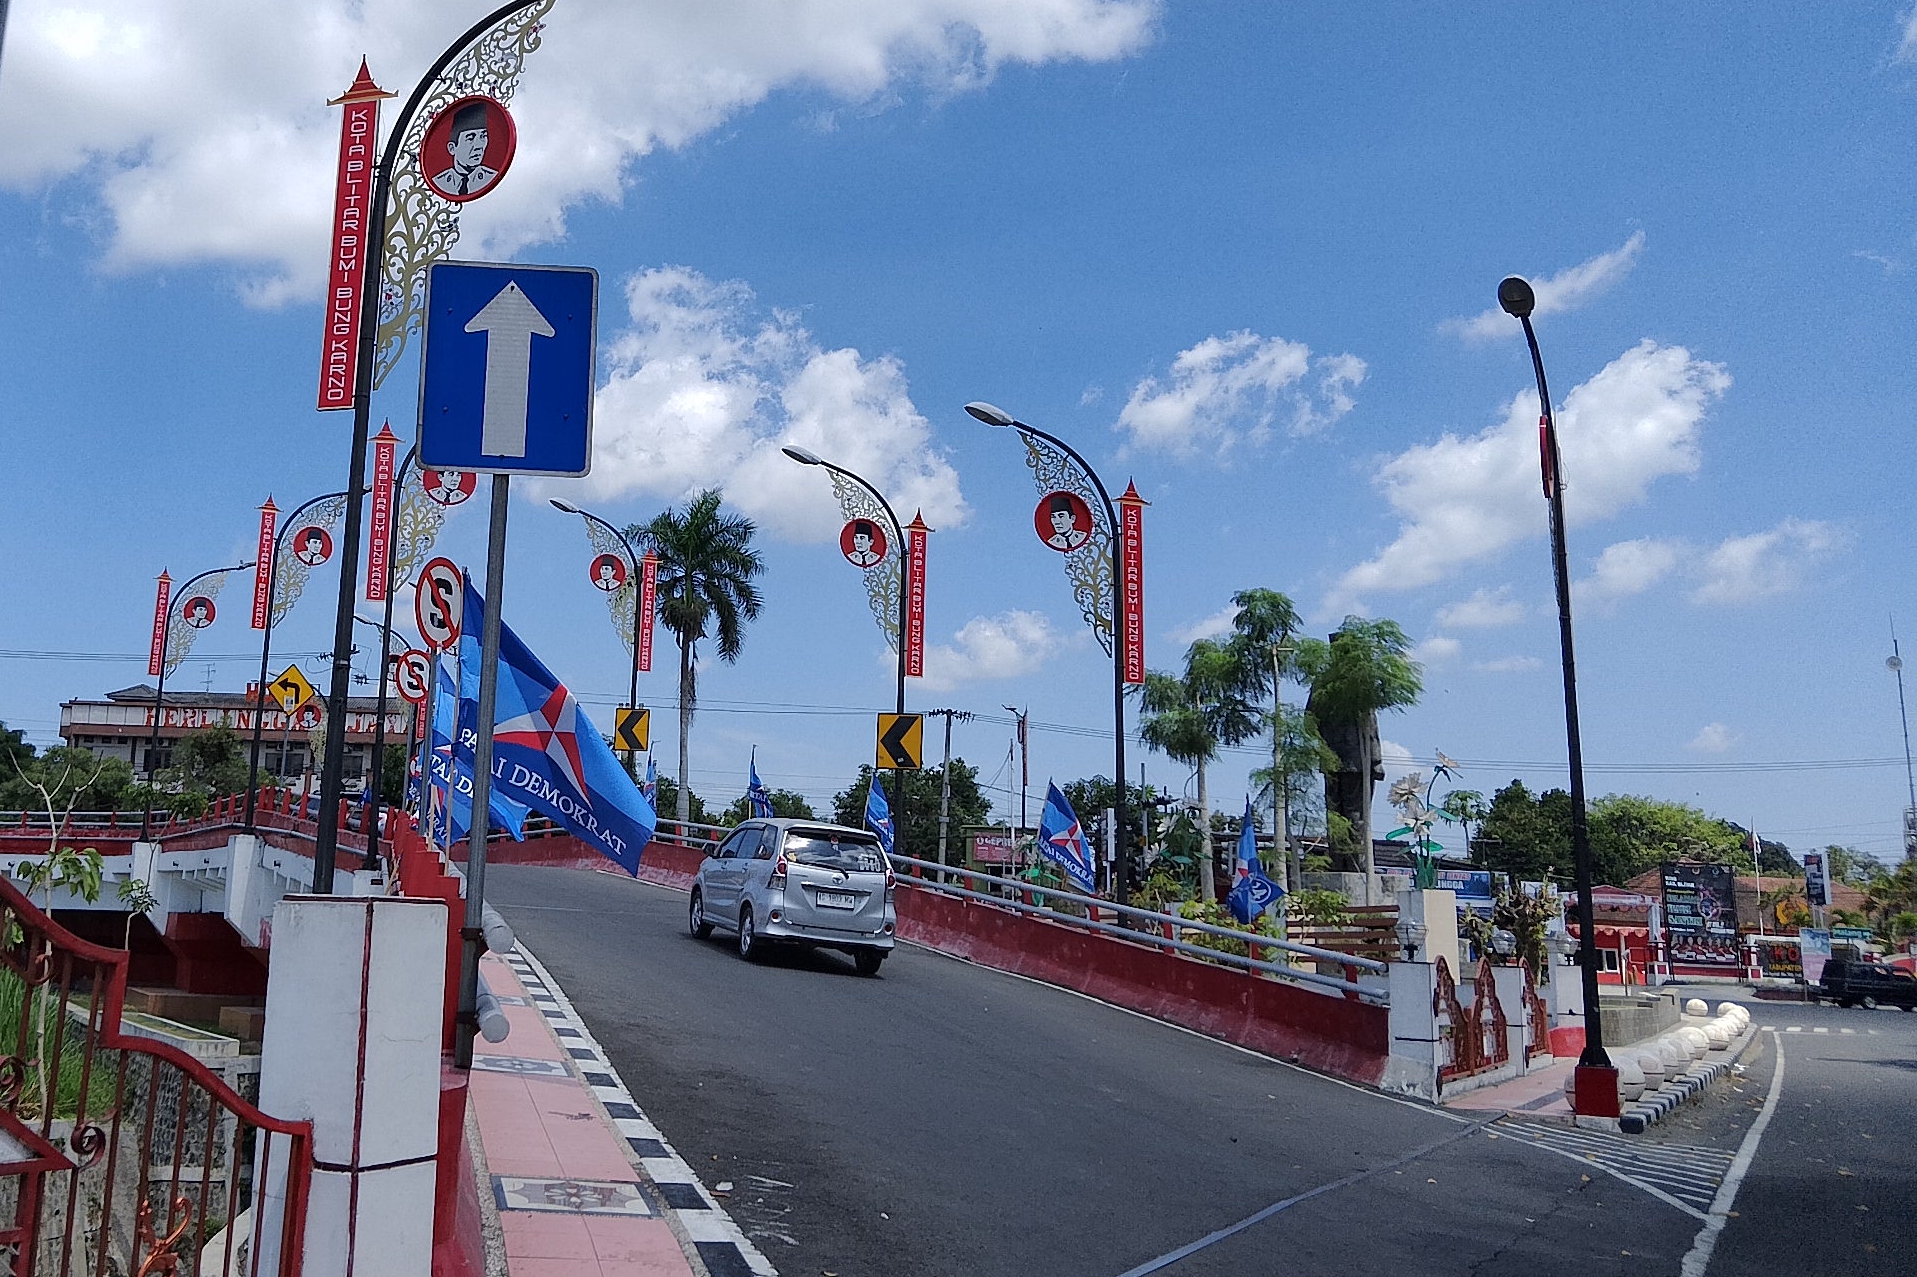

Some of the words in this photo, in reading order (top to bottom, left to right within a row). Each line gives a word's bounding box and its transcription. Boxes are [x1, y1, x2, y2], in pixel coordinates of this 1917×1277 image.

[349, 109, 368, 156] KOTA
[342, 160, 363, 231] BLITAR
[339, 235, 357, 283] BUMI
[333, 287, 353, 335] BUNG
[327, 339, 348, 401] KARNO
[378, 446, 390, 471] KOTA
[376, 473, 389, 510] BLITAR
[374, 512, 386, 537] BUMI
[1127, 509, 1138, 538] KOTA
[372, 538, 384, 564] BUNG
[913, 535, 923, 558] KOTA
[1127, 540, 1138, 581] BLITAR
[370, 565, 383, 598] KARNO
[913, 560, 923, 594] BLITAR
[430, 578, 452, 629] S
[912, 595, 922, 619] BUMI
[1127, 582, 1138, 611] BUMI
[911, 620, 921, 644] BUNG
[1128, 613, 1139, 642] BUNG
[910, 644, 920, 674] KARNO
[1128, 643, 1140, 680] KARNO
[508, 763, 627, 857] DEMOKRAT
